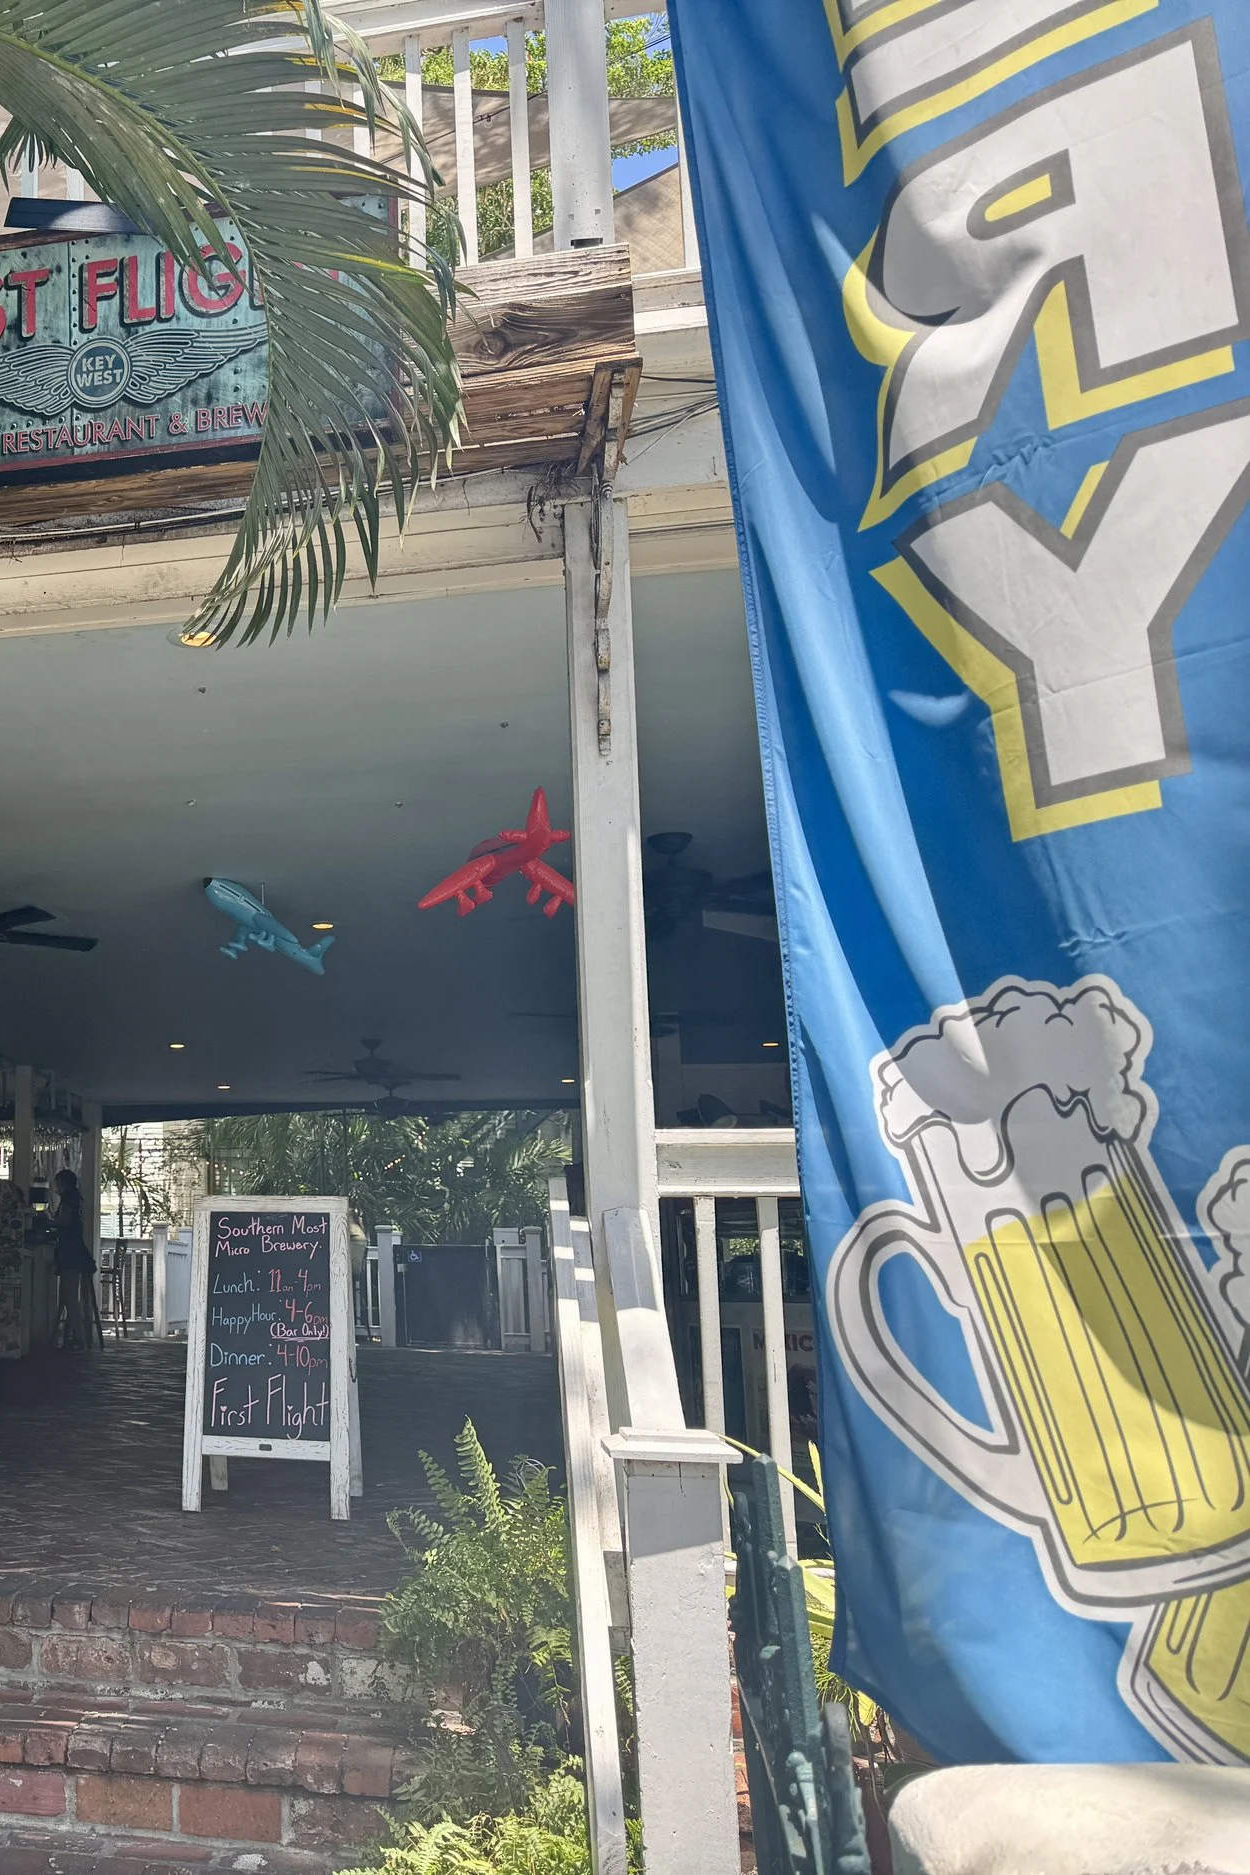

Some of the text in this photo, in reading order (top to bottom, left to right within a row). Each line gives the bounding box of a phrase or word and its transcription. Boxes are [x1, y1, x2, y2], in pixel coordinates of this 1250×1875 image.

[80, 240, 342, 331] FLIG
[82, 354, 117, 372] KEY
[76, 368, 124, 388] WEST
[2, 413, 162, 455] RESTAURANT
[168, 411, 189, 434] &
[197, 399, 269, 432] BREW
[217, 1214, 328, 1240] Southern Most
[215, 1240, 251, 1258] Micro
[213, 1269, 261, 1295] Lunch:
[212, 1306, 252, 1335] Happy
[270, 1322, 298, 1338] (Bar
[209, 1342, 328, 1376] Dinner: 4-10pm
[211, 1373, 330, 1440] First Flight
